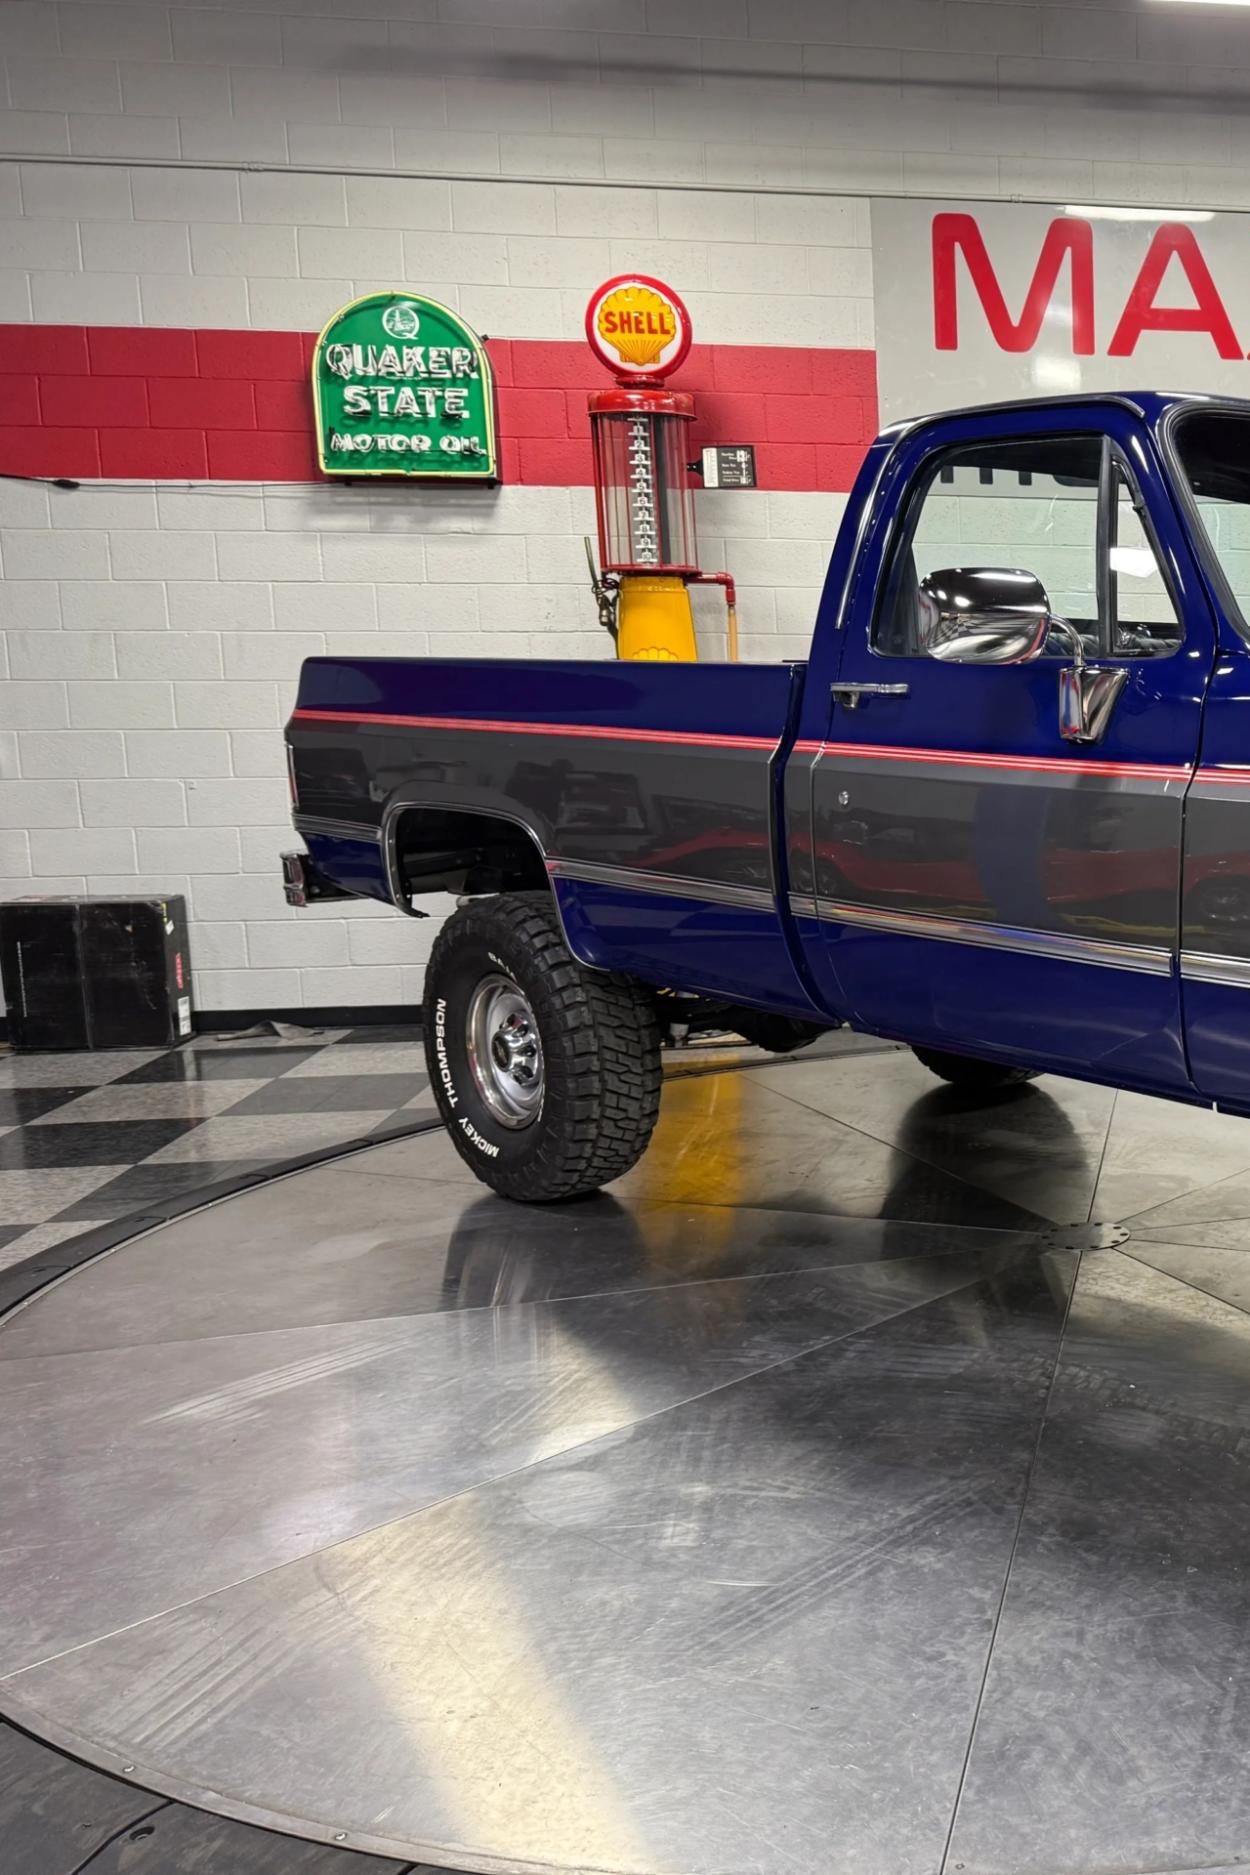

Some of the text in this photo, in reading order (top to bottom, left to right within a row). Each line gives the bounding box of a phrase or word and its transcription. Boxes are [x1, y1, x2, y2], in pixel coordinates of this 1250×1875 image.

[603, 311, 671, 335] SHELL
[325, 343, 480, 380] QUAKER
[343, 385, 470, 419] STATE
[330, 432, 487, 455] MOTOR OIL
[435, 998, 500, 1158] MICKEY THOMPSON
